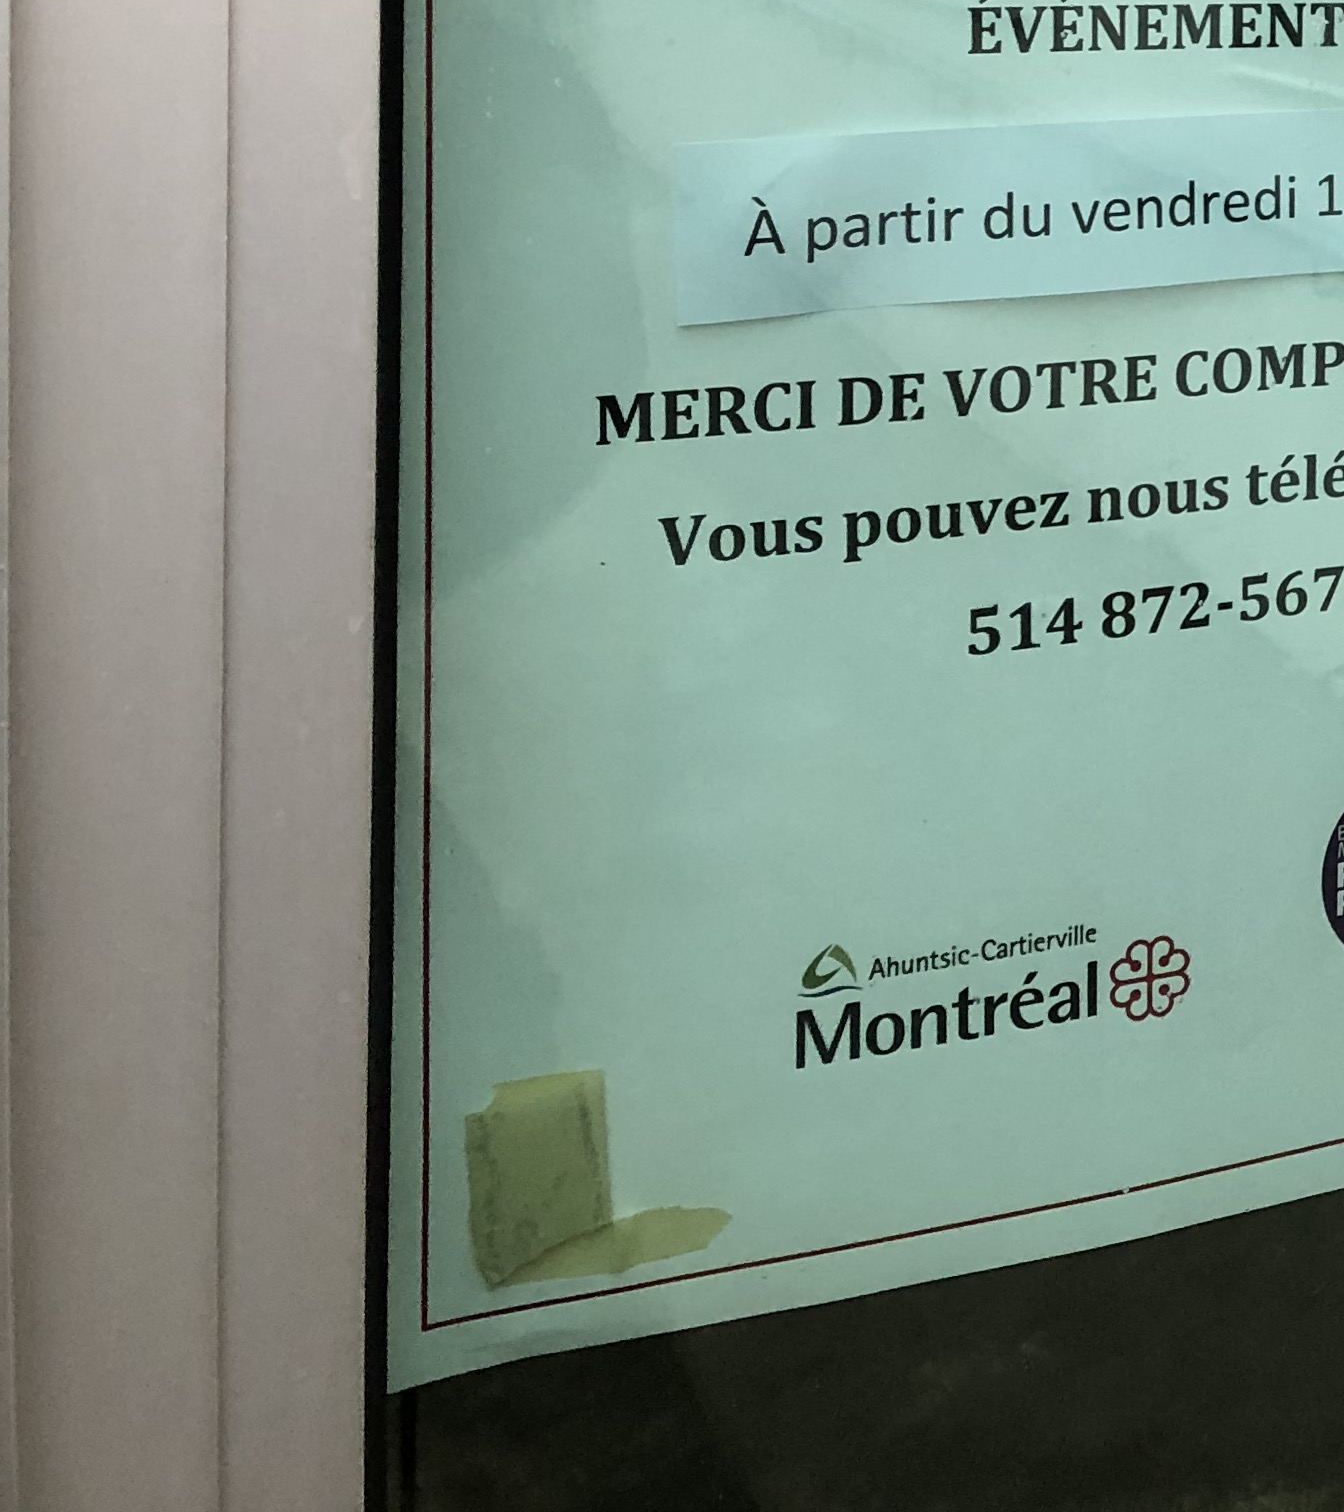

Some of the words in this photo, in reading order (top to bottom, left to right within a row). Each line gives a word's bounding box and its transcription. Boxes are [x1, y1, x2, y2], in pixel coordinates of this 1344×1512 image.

[744, 196, 786, 257] À
[807, 196, 964, 263] partir
[984, 191, 1051, 240] du
[1071, 175, 1296, 234] vendredi
[595, 380, 816, 446] MERCI
[838, 373, 925, 426] DE
[943, 355, 1157, 417] VOTRE
[658, 514, 823, 566] Vous
[843, 491, 1070, 563] pouvez
[1087, 473, 1229, 523] nous
[967, 597, 1083, 656] 514
[868, 924, 1097, 980] Ahuntsic-Cartierville
[795, 961, 1098, 1070] Montréal
